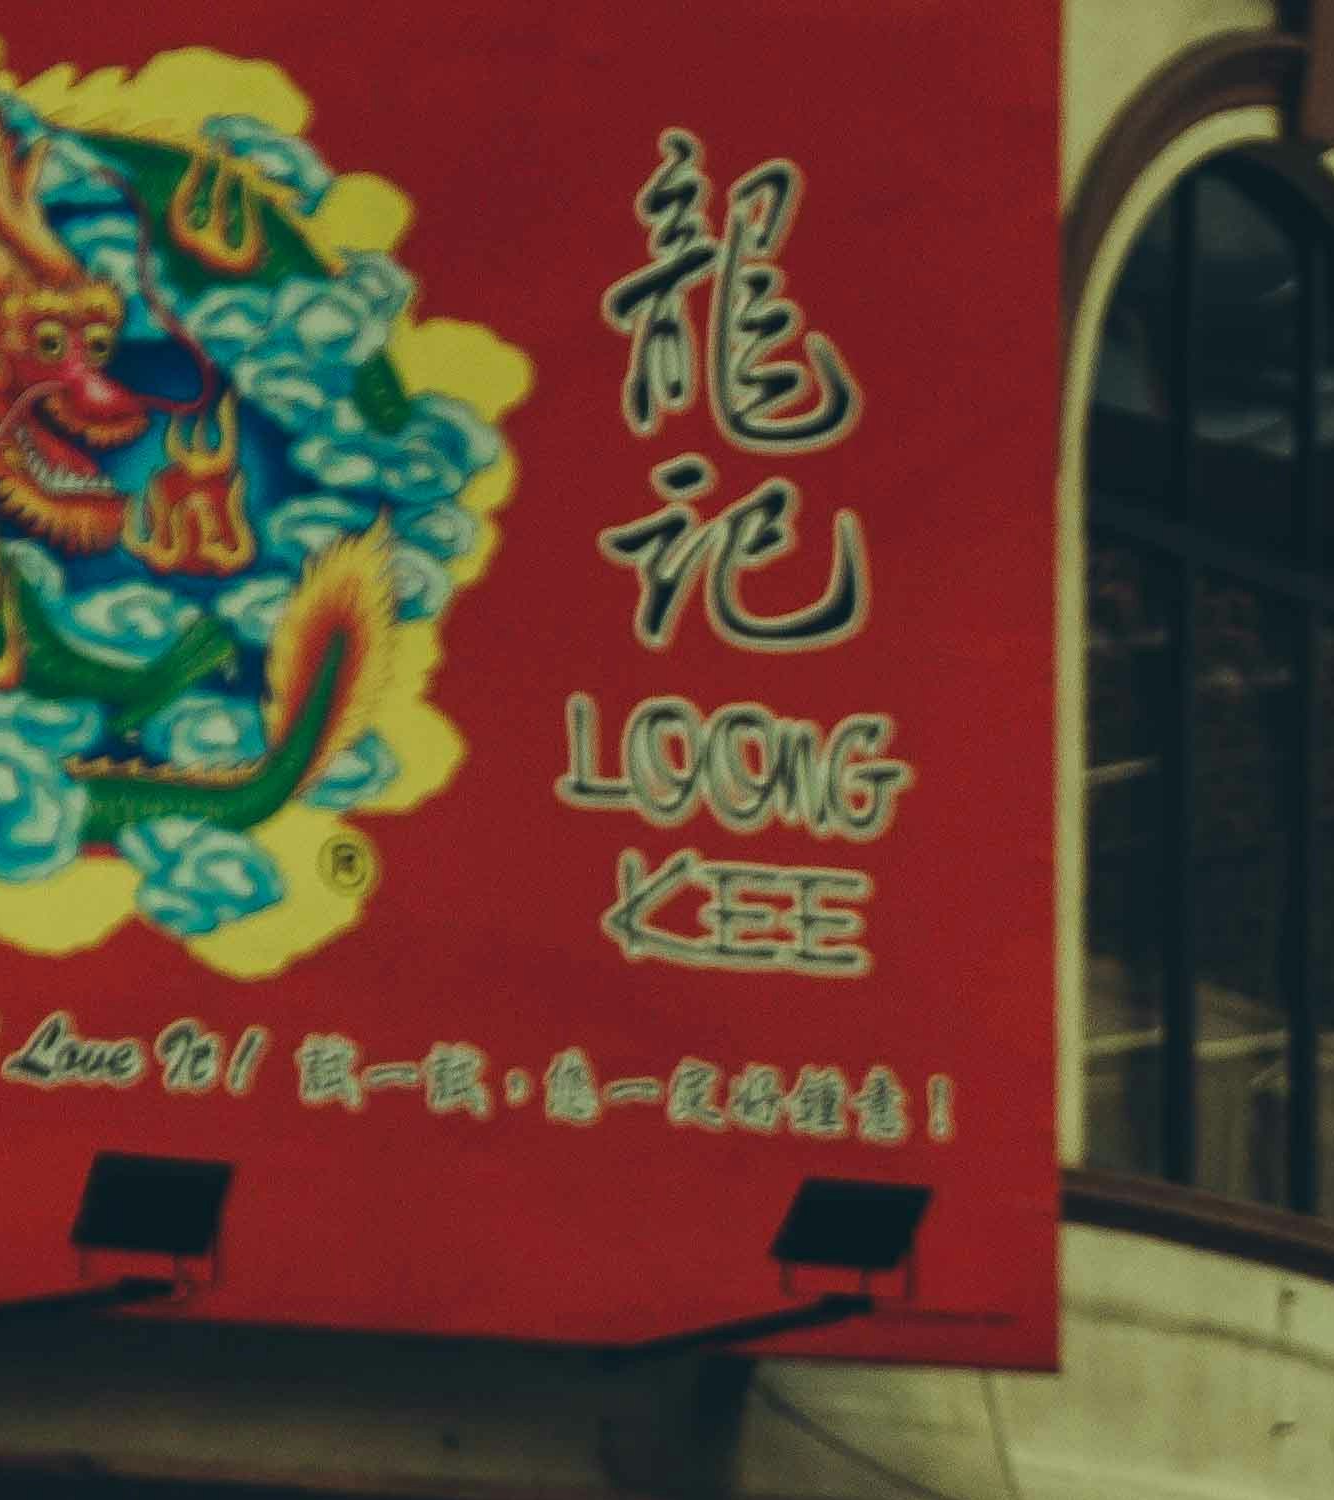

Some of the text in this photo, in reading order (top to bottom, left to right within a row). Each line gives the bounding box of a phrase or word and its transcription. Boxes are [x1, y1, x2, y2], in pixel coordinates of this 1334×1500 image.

[600, 127, 867, 650] 龍記
[555, 690, 913, 842] LOONG
[603, 846, 871, 978] KEE
[0, 1010, 144, 1088] Love
